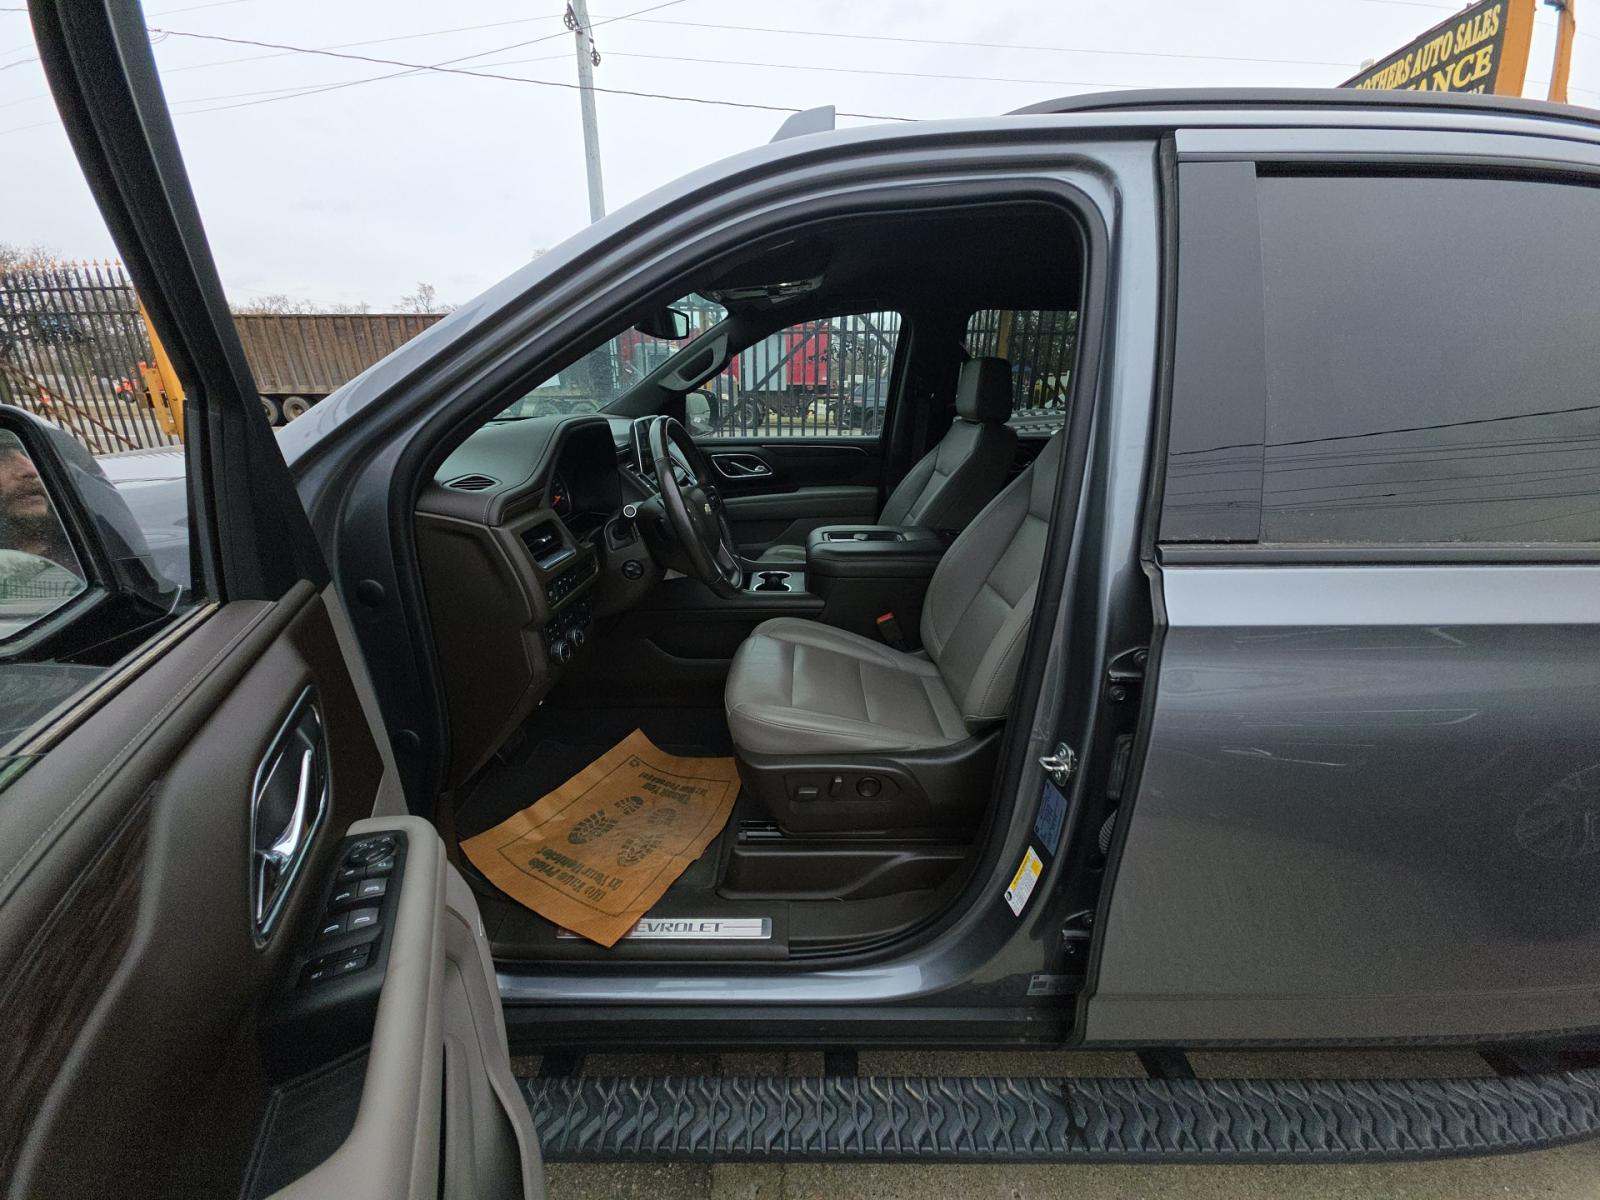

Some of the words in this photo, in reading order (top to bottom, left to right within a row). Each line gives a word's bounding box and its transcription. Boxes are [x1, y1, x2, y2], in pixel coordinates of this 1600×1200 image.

[1356, 53, 1413, 90] THERS
[1410, 31, 1453, 78] AUTO
[1454, 4, 1501, 55] SALES
[1406, 44, 1494, 92] ANCE
